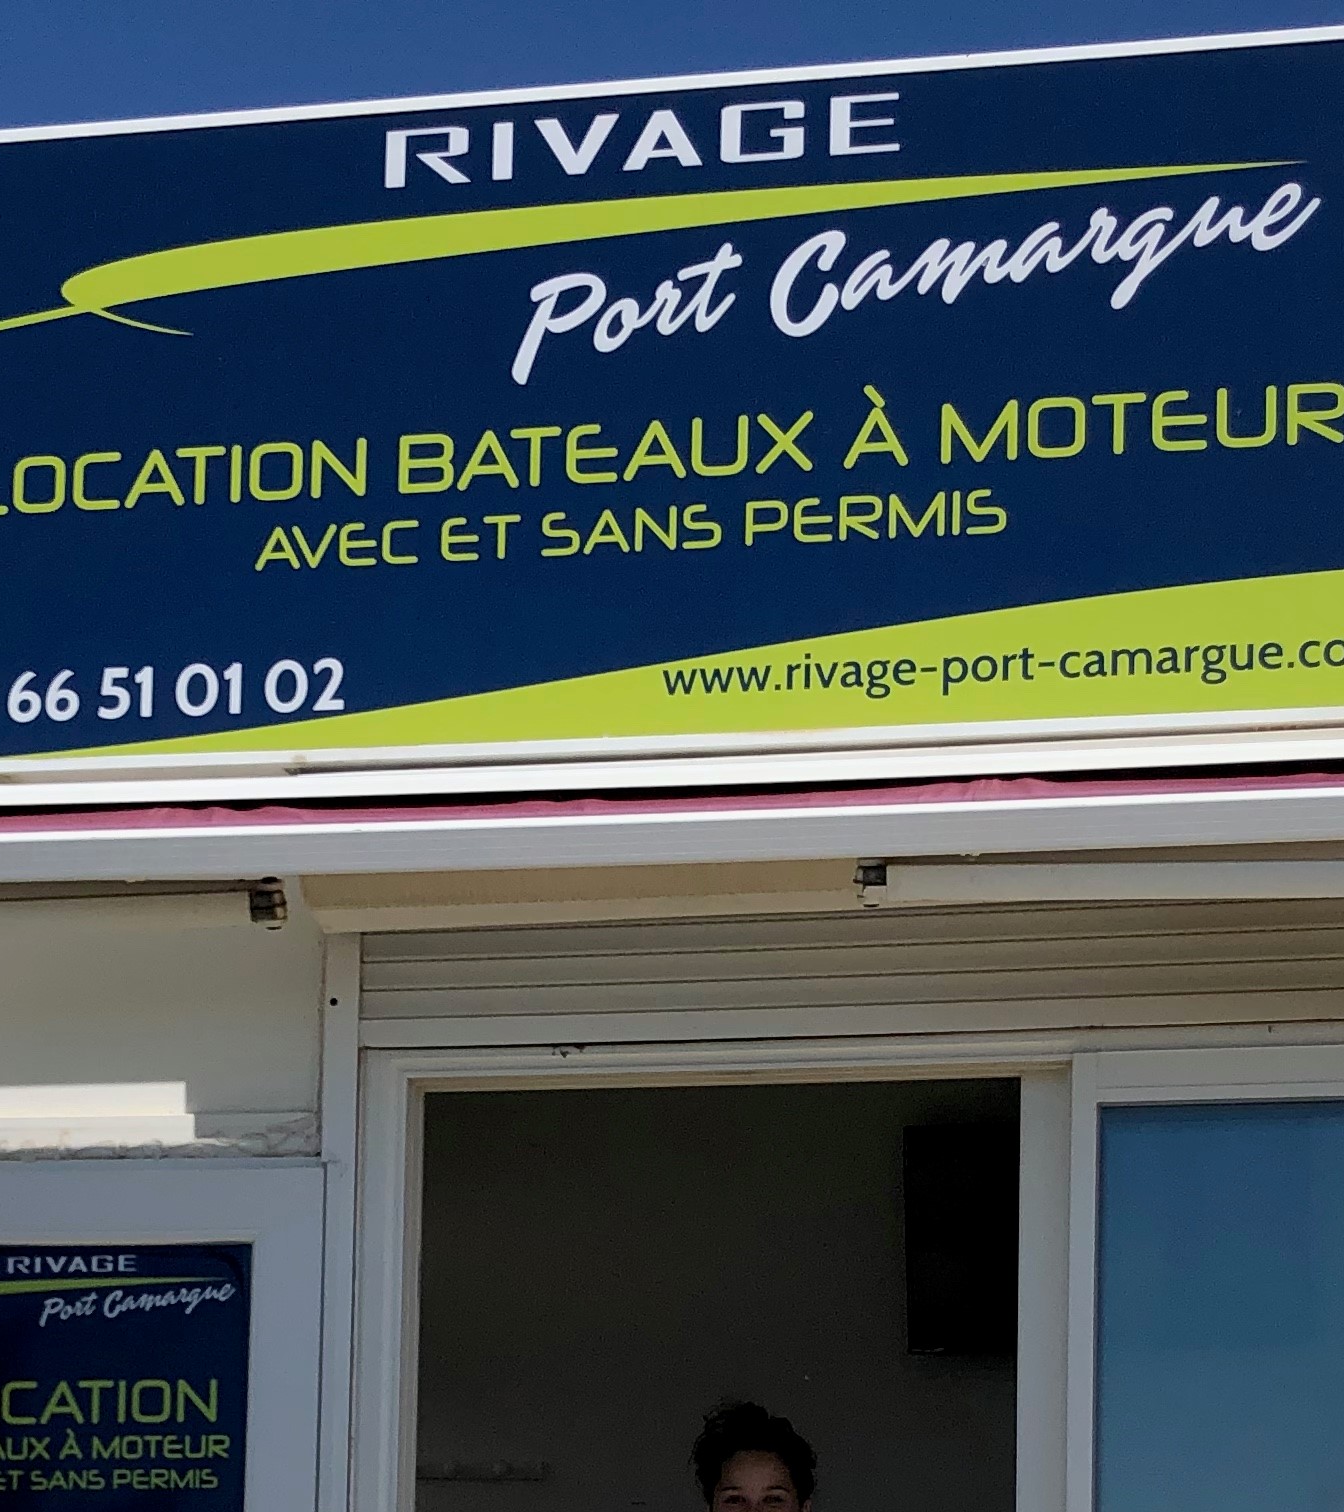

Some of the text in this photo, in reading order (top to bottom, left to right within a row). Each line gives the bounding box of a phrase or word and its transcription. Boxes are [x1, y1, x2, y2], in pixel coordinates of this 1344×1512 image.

[383, 90, 901, 190] RIVAGE
[512, 179, 1320, 385] Port Camargue
[398, 411, 813, 493] BATEAUX
[842, 386, 909, 471] À
[255, 489, 1006, 571] AVEC ET SANS PERMIS
[8, 670, 79, 722] 66
[98, 666, 153, 719] 51
[176, 662, 242, 716] 01
[265, 658, 344, 713] 02
[8, 1255, 136, 1273] RIVAGE
[39, 1284, 235, 1327] Port Camargue
[59, 1429, 82, 1459] À
[92, 1435, 230, 1459] MOTEUR
[31, 1470, 105, 1490] SANS
[113, 1469, 218, 1489] PERMIS
